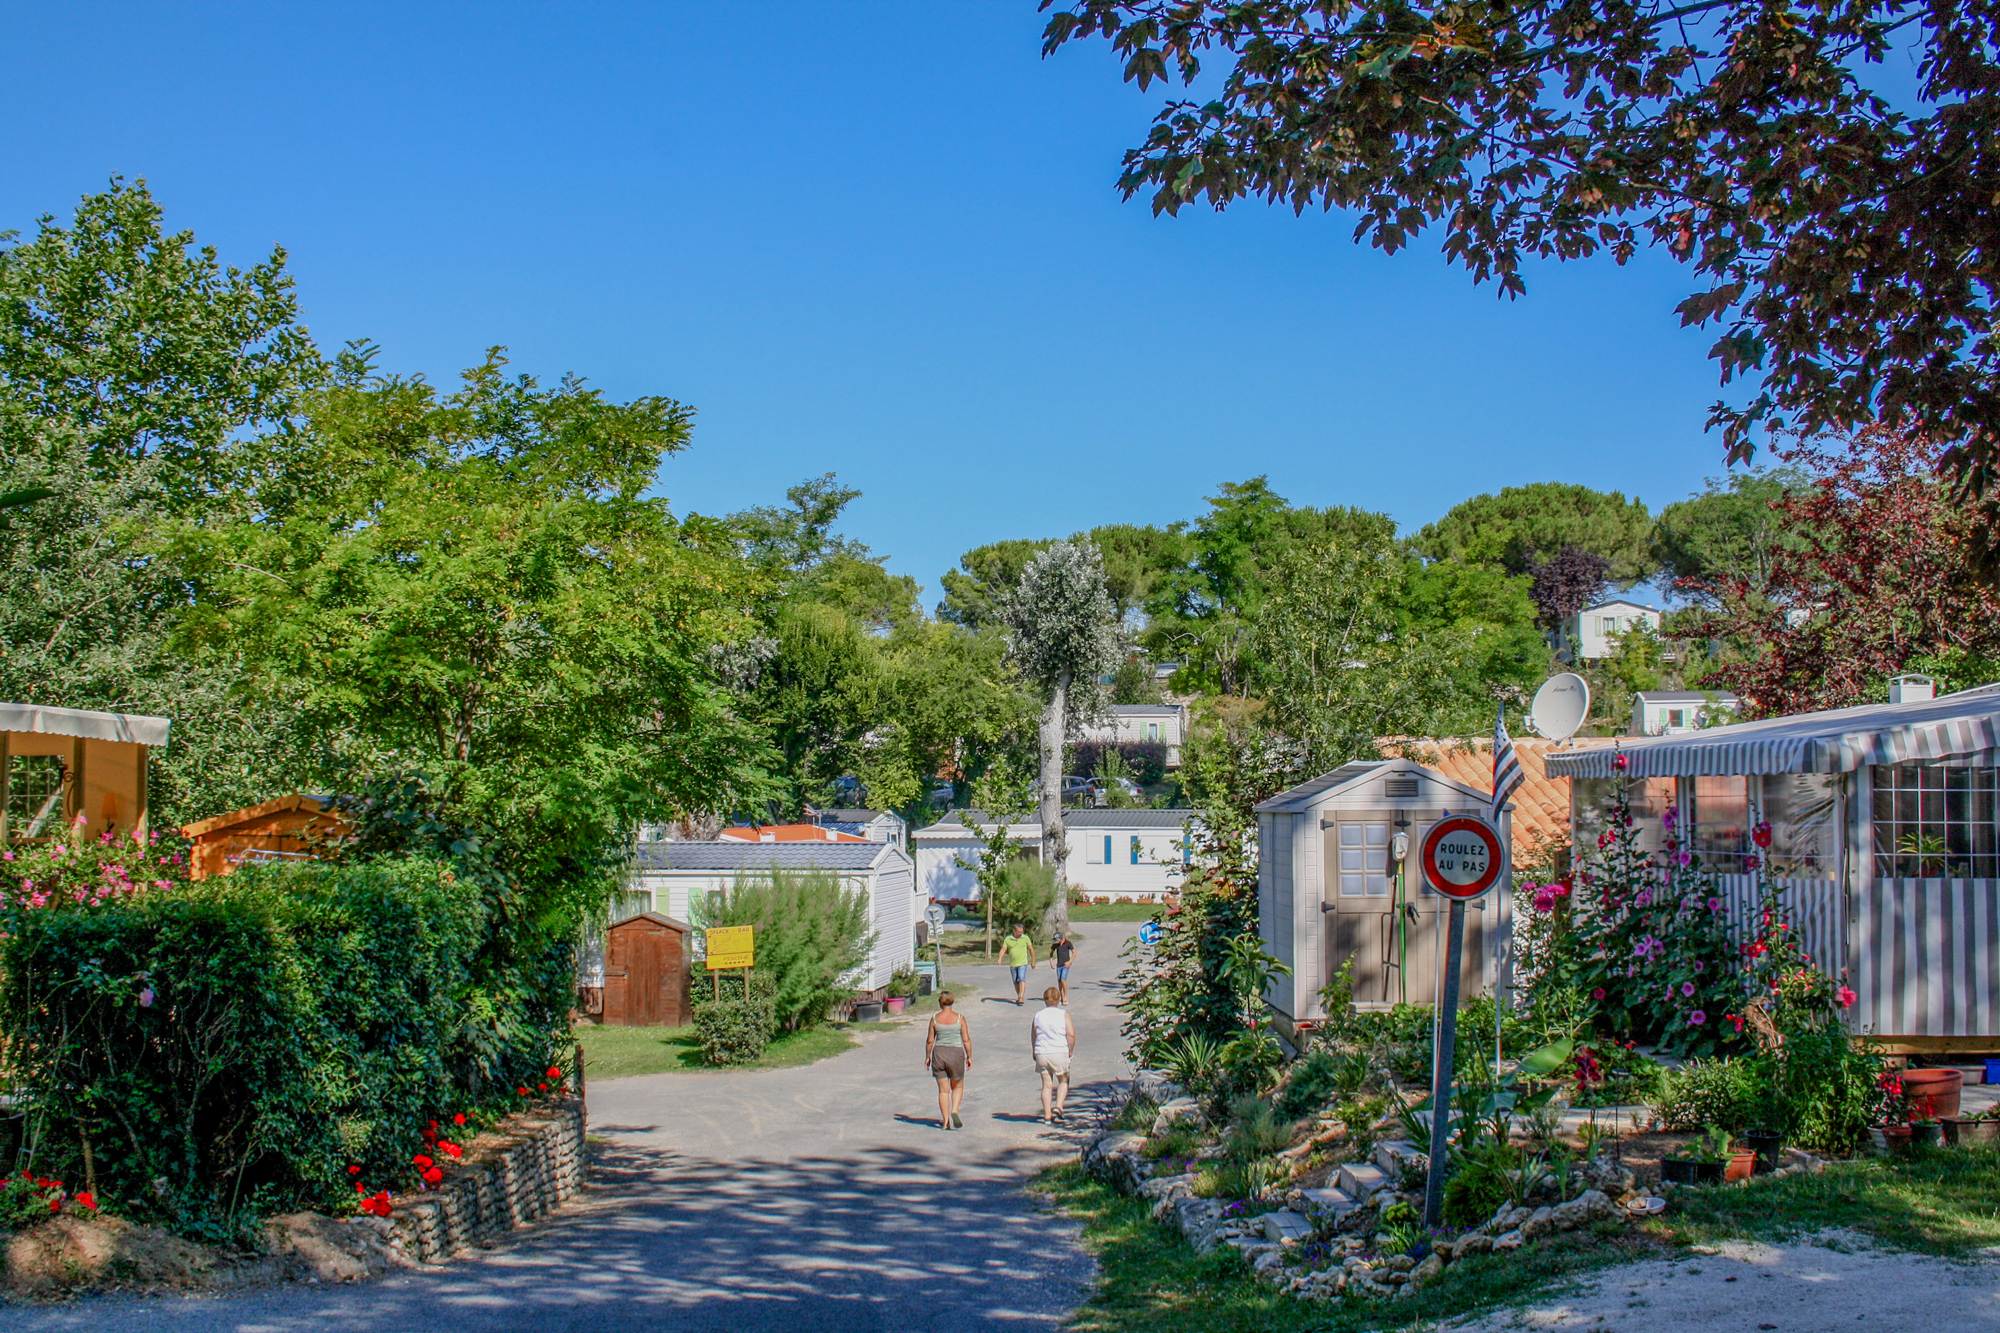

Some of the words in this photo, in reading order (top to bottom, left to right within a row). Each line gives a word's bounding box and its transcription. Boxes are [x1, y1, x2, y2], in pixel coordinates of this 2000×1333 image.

[1440, 843, 1485, 856] ROULEZ
[1438, 860, 1454, 870] AU
[1462, 861, 1485, 872] PAS
